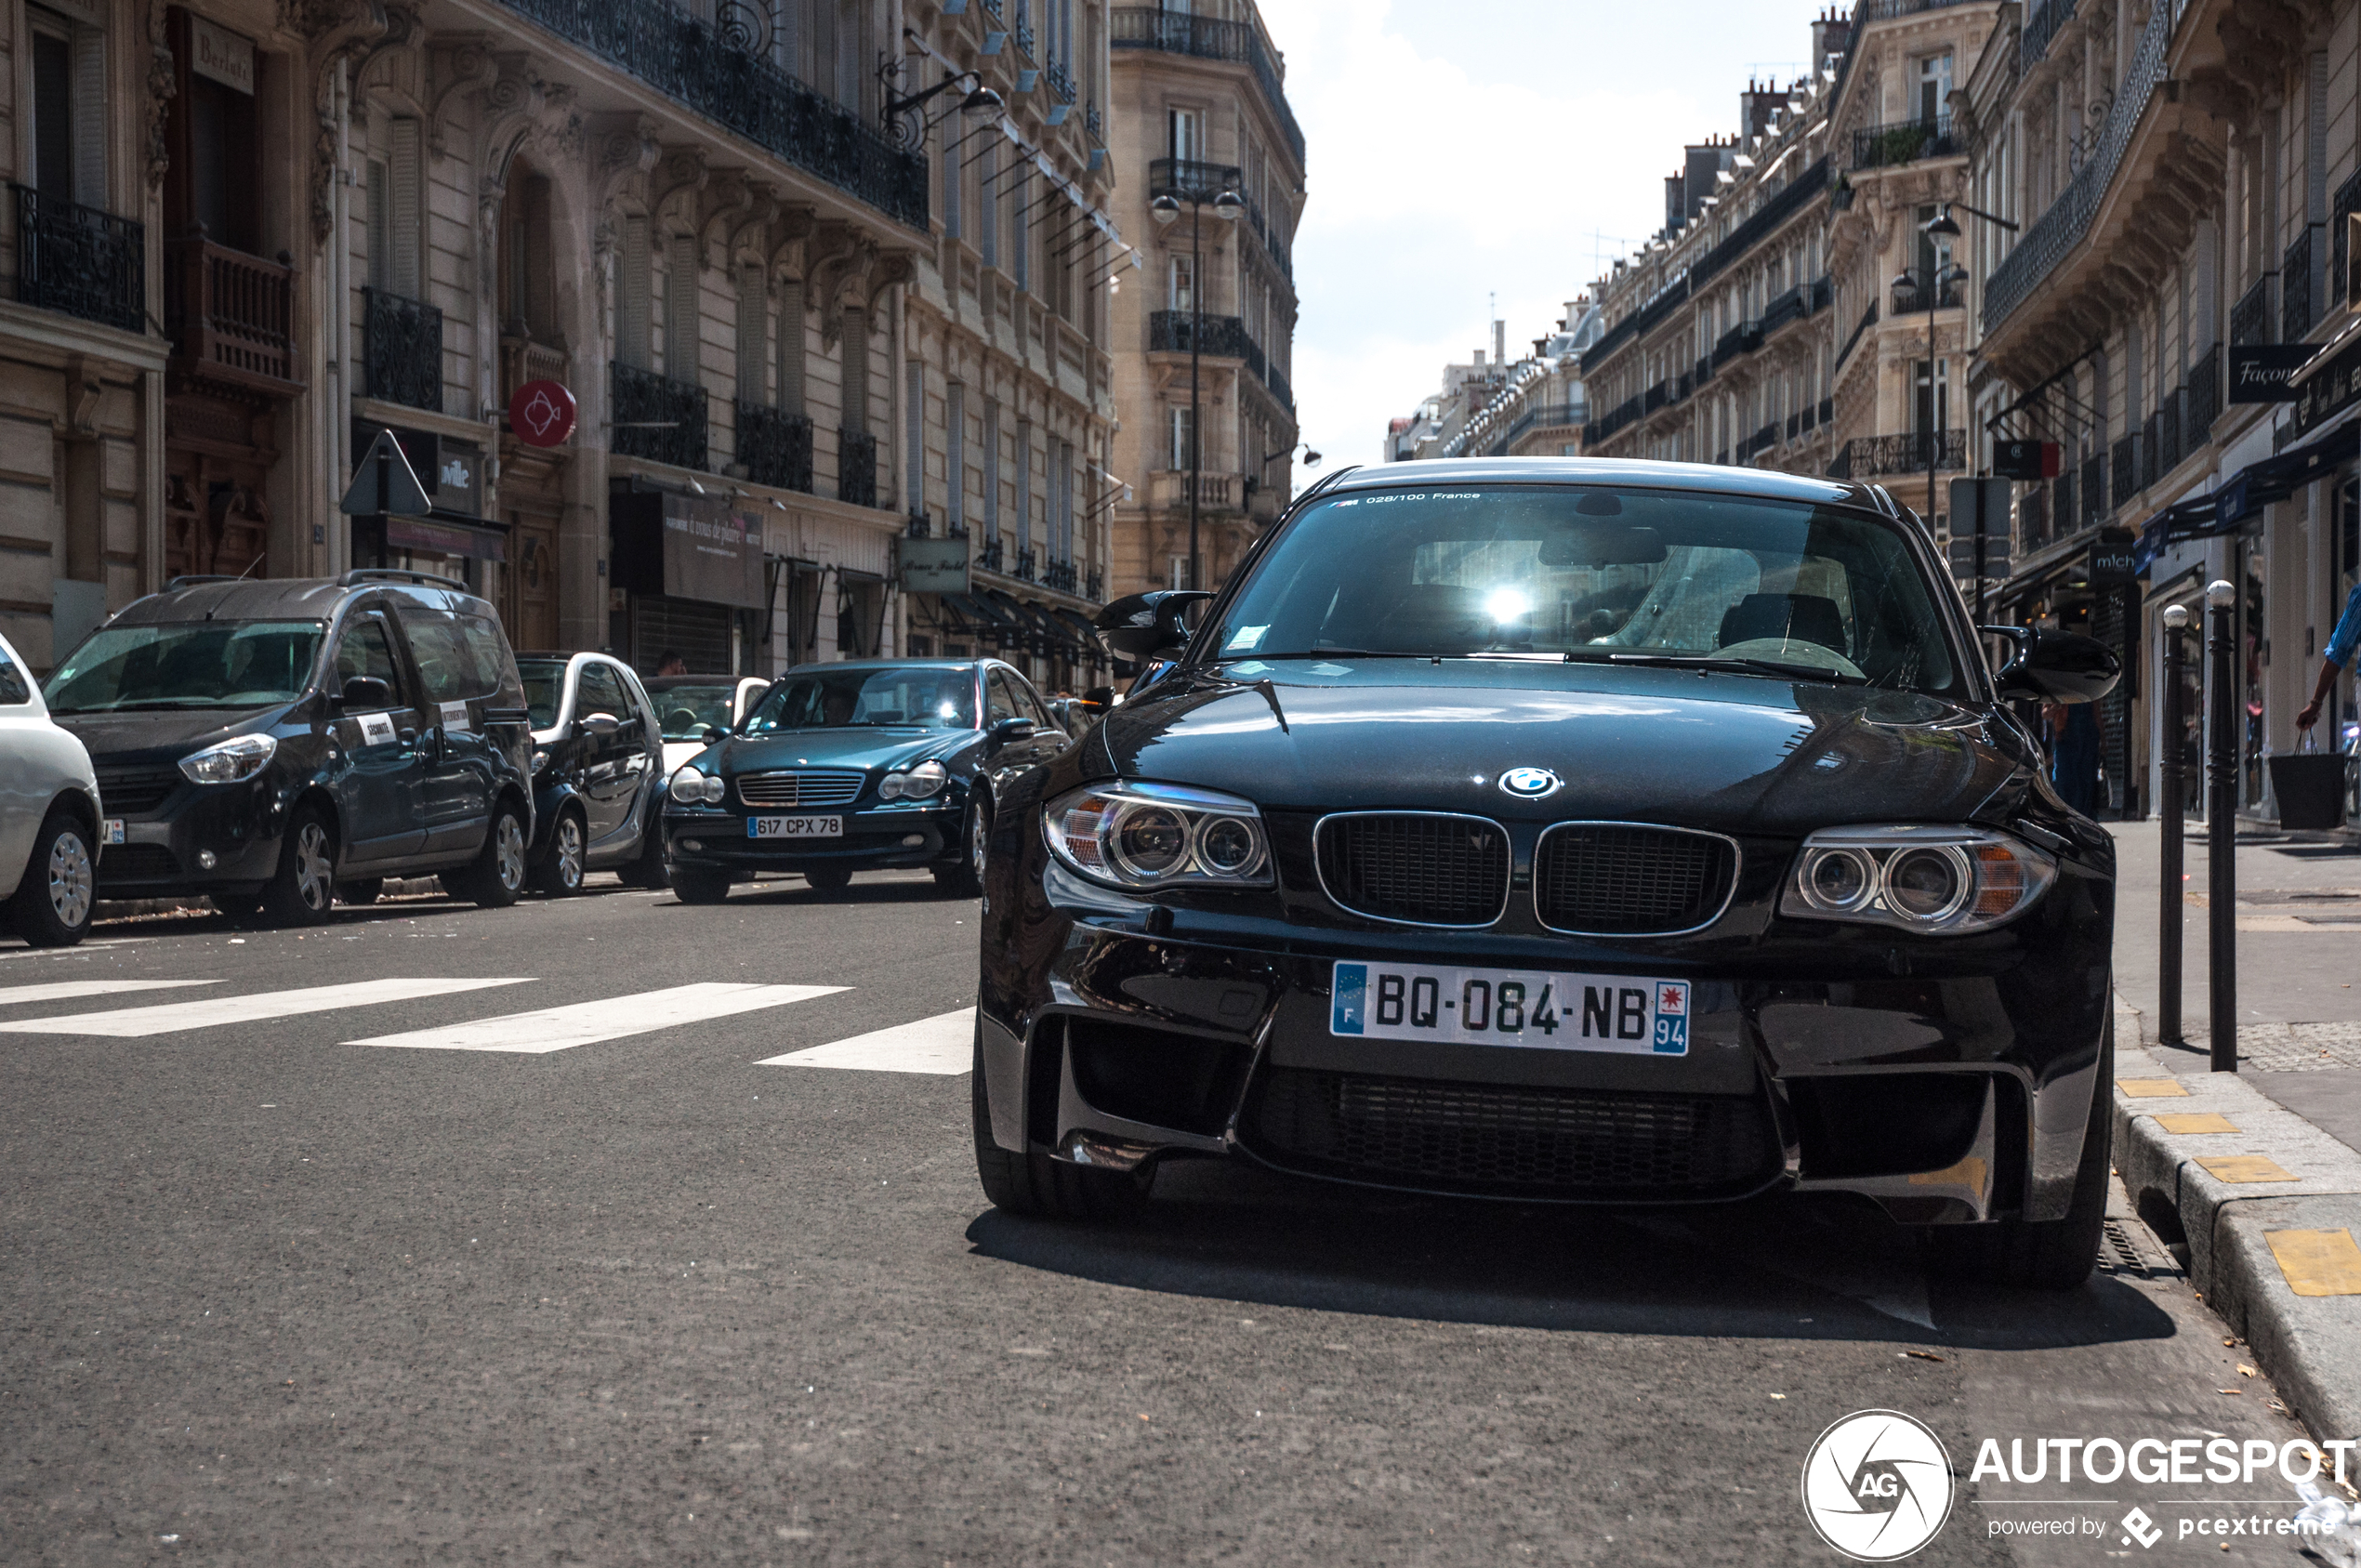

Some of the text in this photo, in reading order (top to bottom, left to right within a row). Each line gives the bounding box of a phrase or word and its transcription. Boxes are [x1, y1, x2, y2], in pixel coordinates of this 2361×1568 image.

[1366, 494, 1426, 505] 028/100
[695, 520, 712, 537] vous
[712, 518, 720, 540] de
[758, 819, 838, 834] 617 CPX 78
[1344, 974, 1684, 1046] F BQ-084-NB 94
